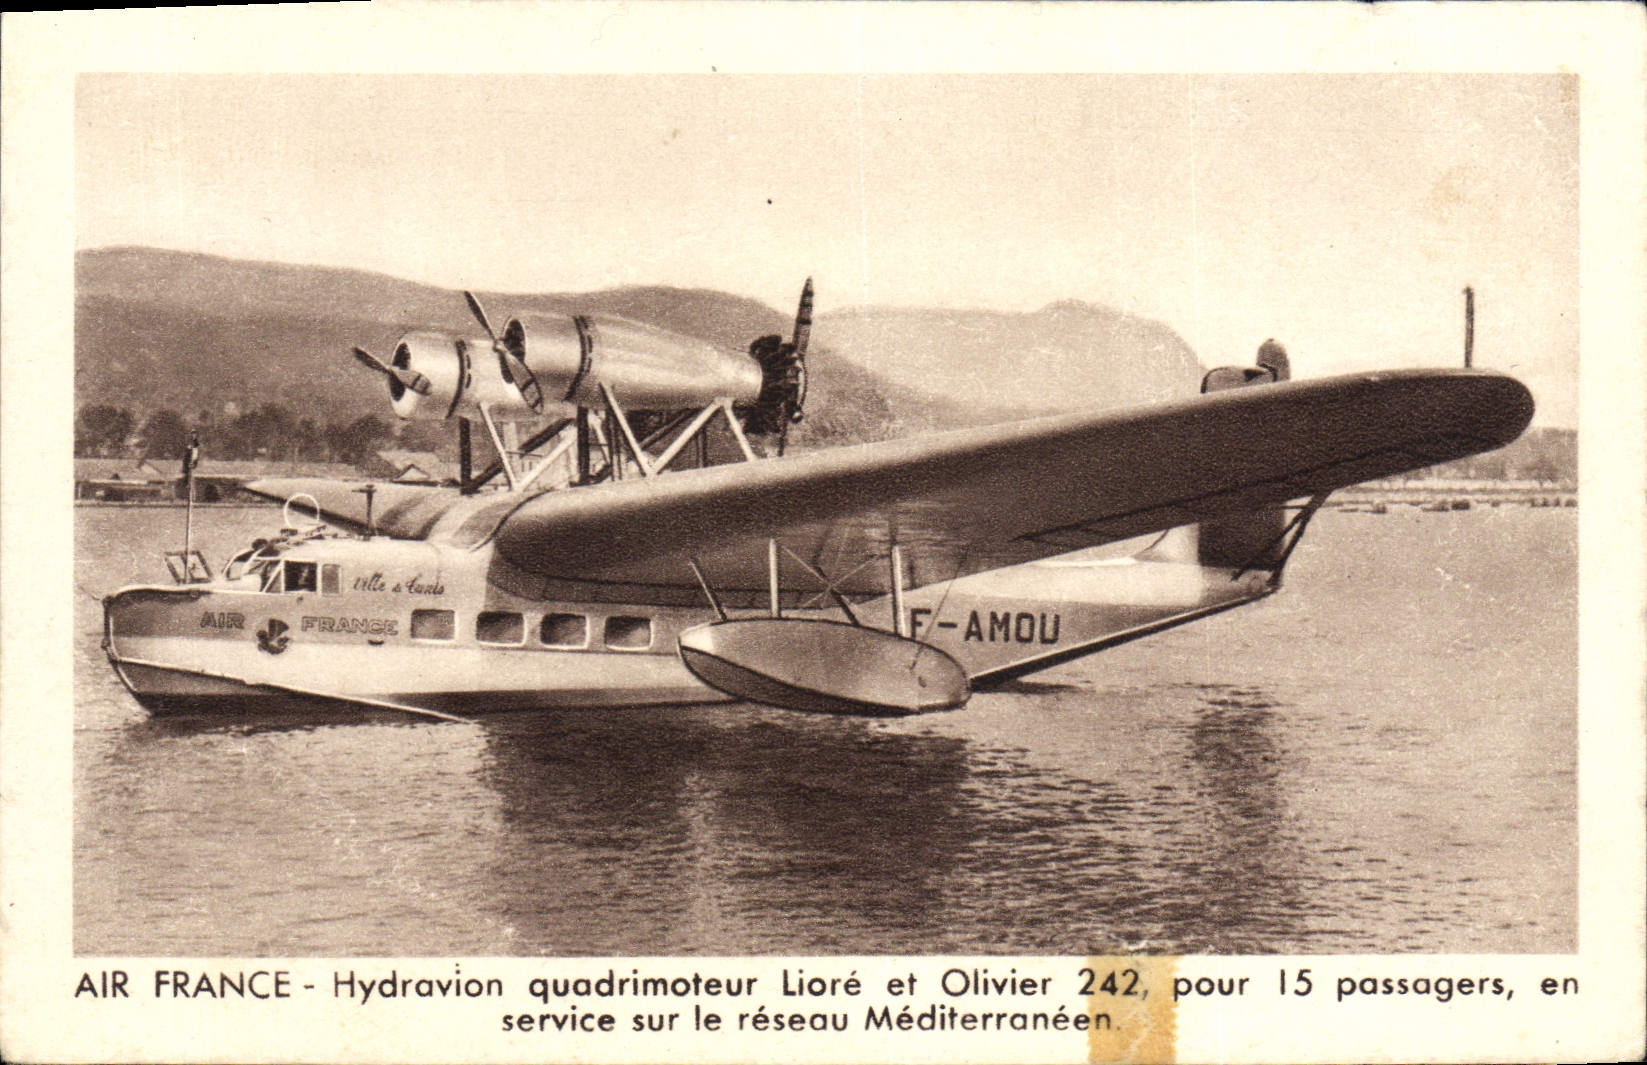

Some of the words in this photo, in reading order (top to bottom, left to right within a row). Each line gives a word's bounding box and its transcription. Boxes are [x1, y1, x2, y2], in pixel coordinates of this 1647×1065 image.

[200, 611, 245, 630] AIR
[300, 616, 399, 636] FRANCE
[910, 607, 1060, 645] F-AMOU
